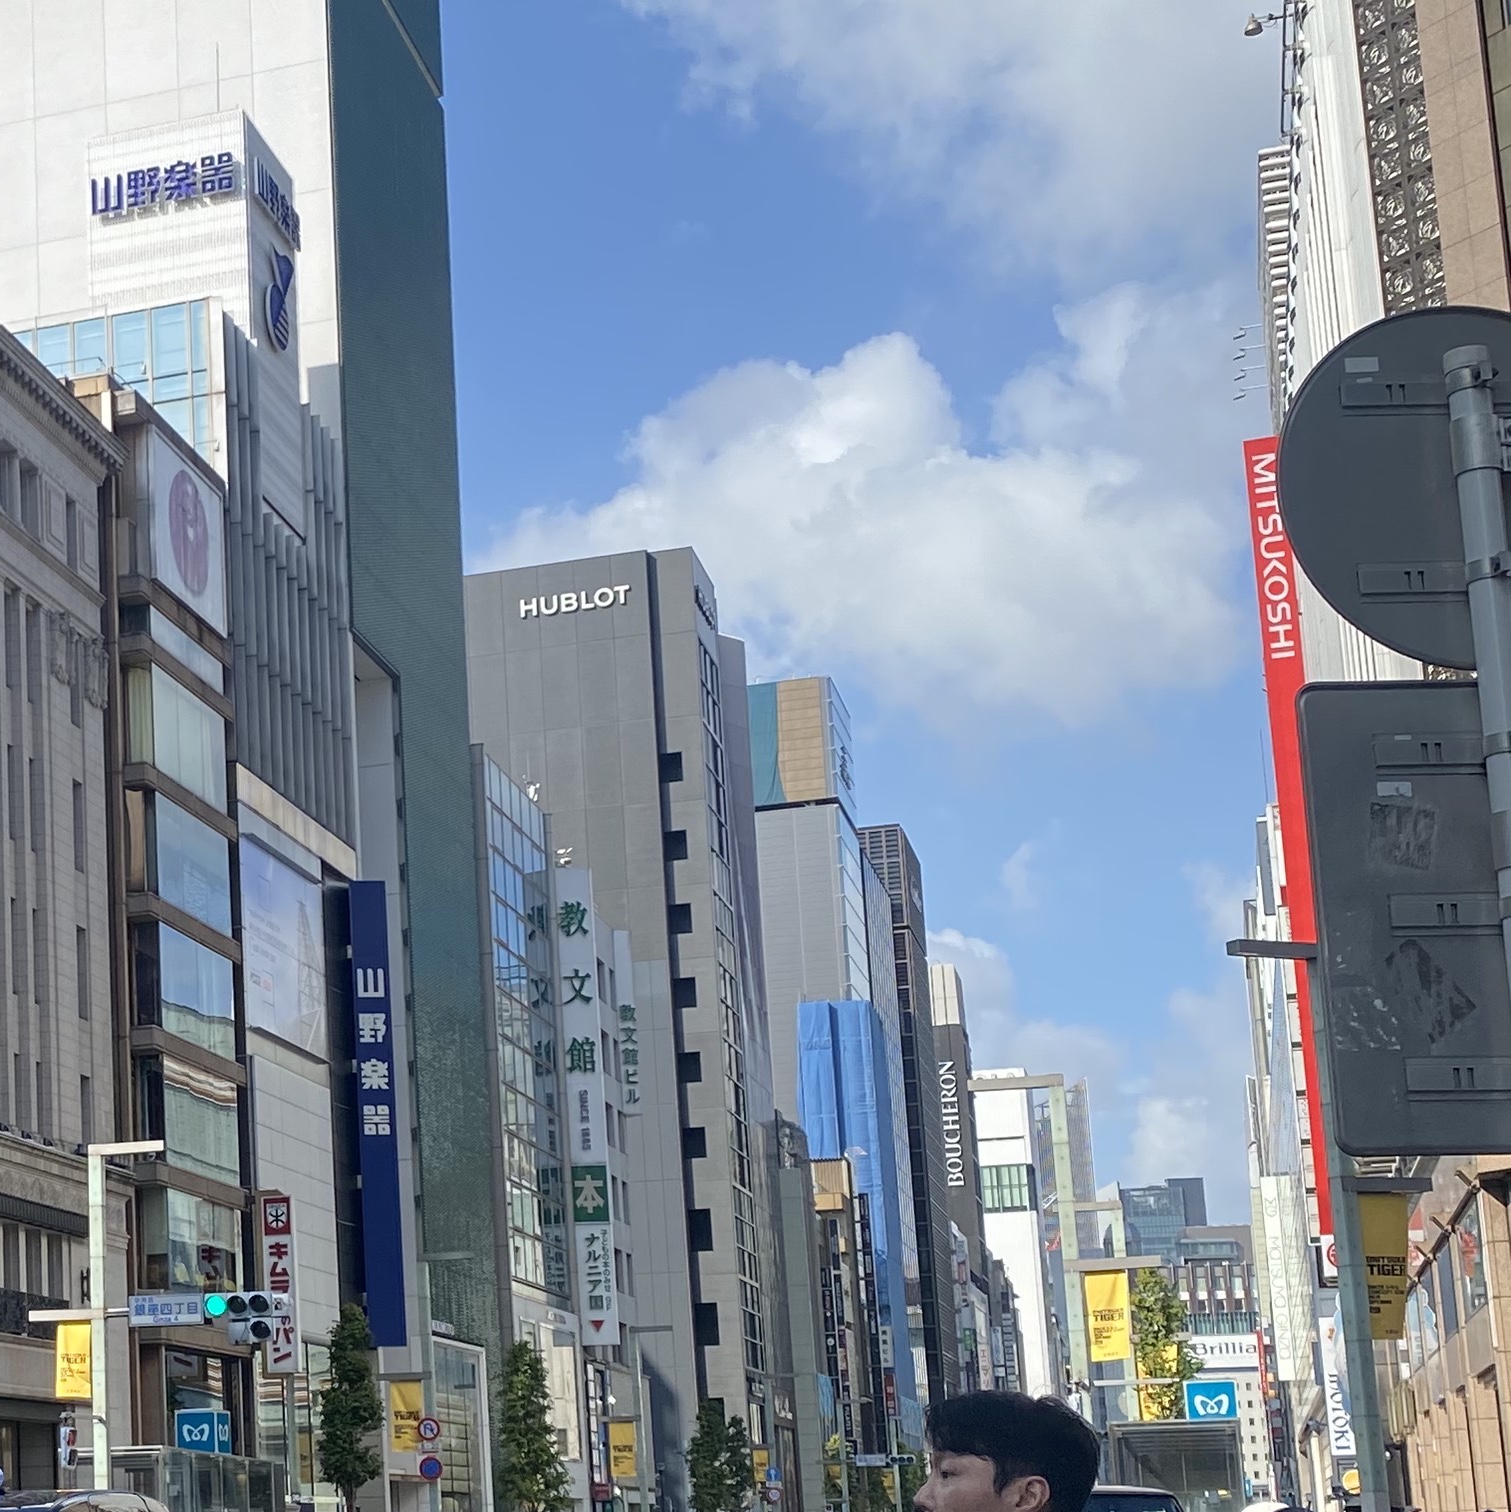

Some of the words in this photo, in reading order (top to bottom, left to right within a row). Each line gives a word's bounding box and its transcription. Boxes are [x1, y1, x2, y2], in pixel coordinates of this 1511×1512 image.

[90, 152, 233, 216] 山野楽器
[1251, 452, 1296, 660] MITSUKOSHI
[519, 584, 631, 619] HUBLOT
[558, 900, 596, 1073] 教文館
[356, 967, 391, 1136] 山野楽器
[619, 1003, 641, 1105] 教文館ビル
[938, 1060, 966, 1187] BOUCHERON
[574, 1174, 605, 1214] 本
[135, 1302, 198, 1316] 銀座四丁目
[585, 1233, 605, 1311] ナルニア国
